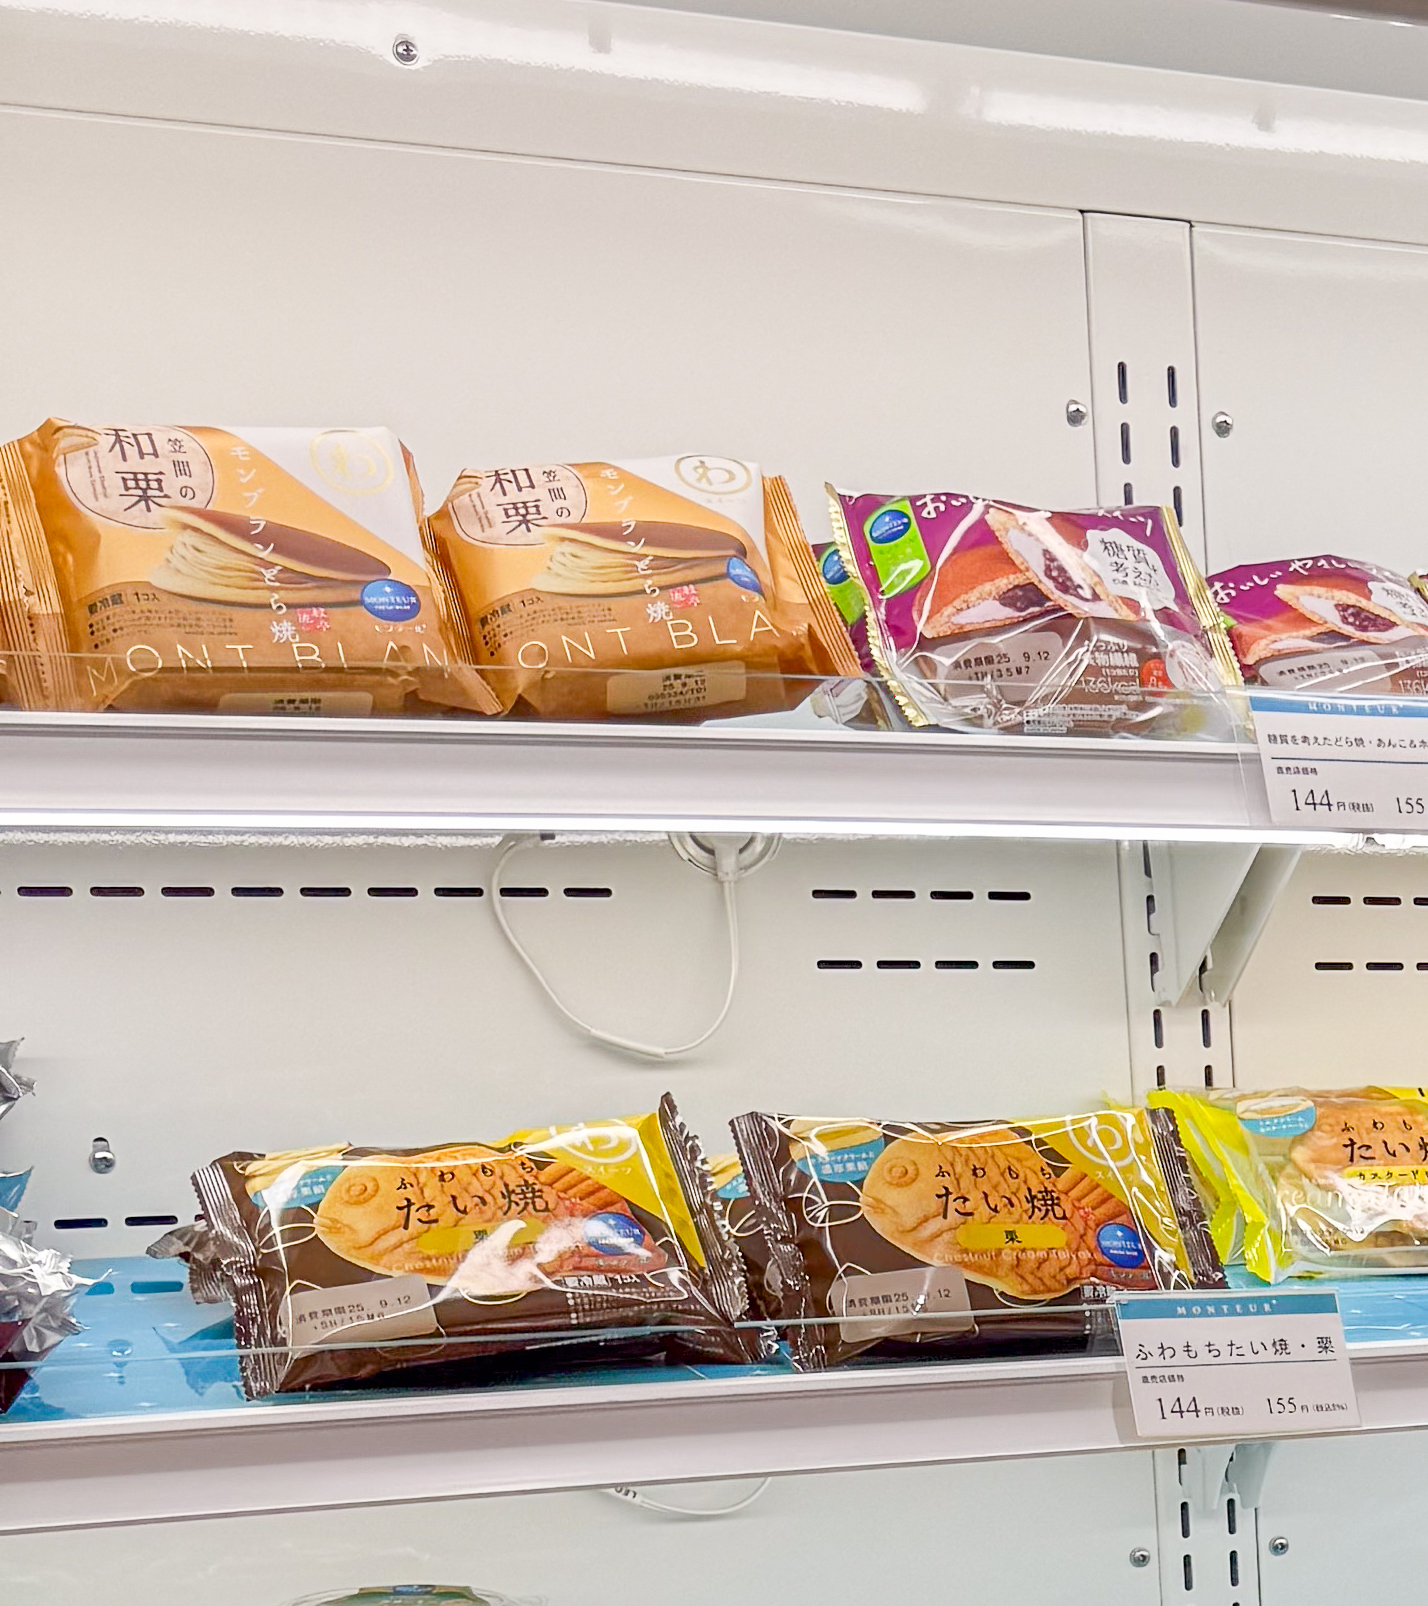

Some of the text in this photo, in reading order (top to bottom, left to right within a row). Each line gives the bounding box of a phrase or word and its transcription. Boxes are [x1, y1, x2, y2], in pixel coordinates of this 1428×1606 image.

[107, 427, 172, 514] 和栗
[166, 436, 197, 502] 笠間の
[488, 466, 548, 537] 和栗
[542, 469, 571, 520] 笠間の
[229, 444, 300, 646] モンブランどら焼
[600, 467, 674, 624] モンブランどら焼
[396, 1160, 536, 1191] ふわもち
[934, 1163, 1054, 1181] ふわもち
[396, 1182, 551, 1231] たい焼
[935, 1186, 1068, 1222] たい焼
[1176, 1302, 1273, 1317] MONTEUR
[1134, 1335, 1337, 1362] ふわもちたい焼・栗
